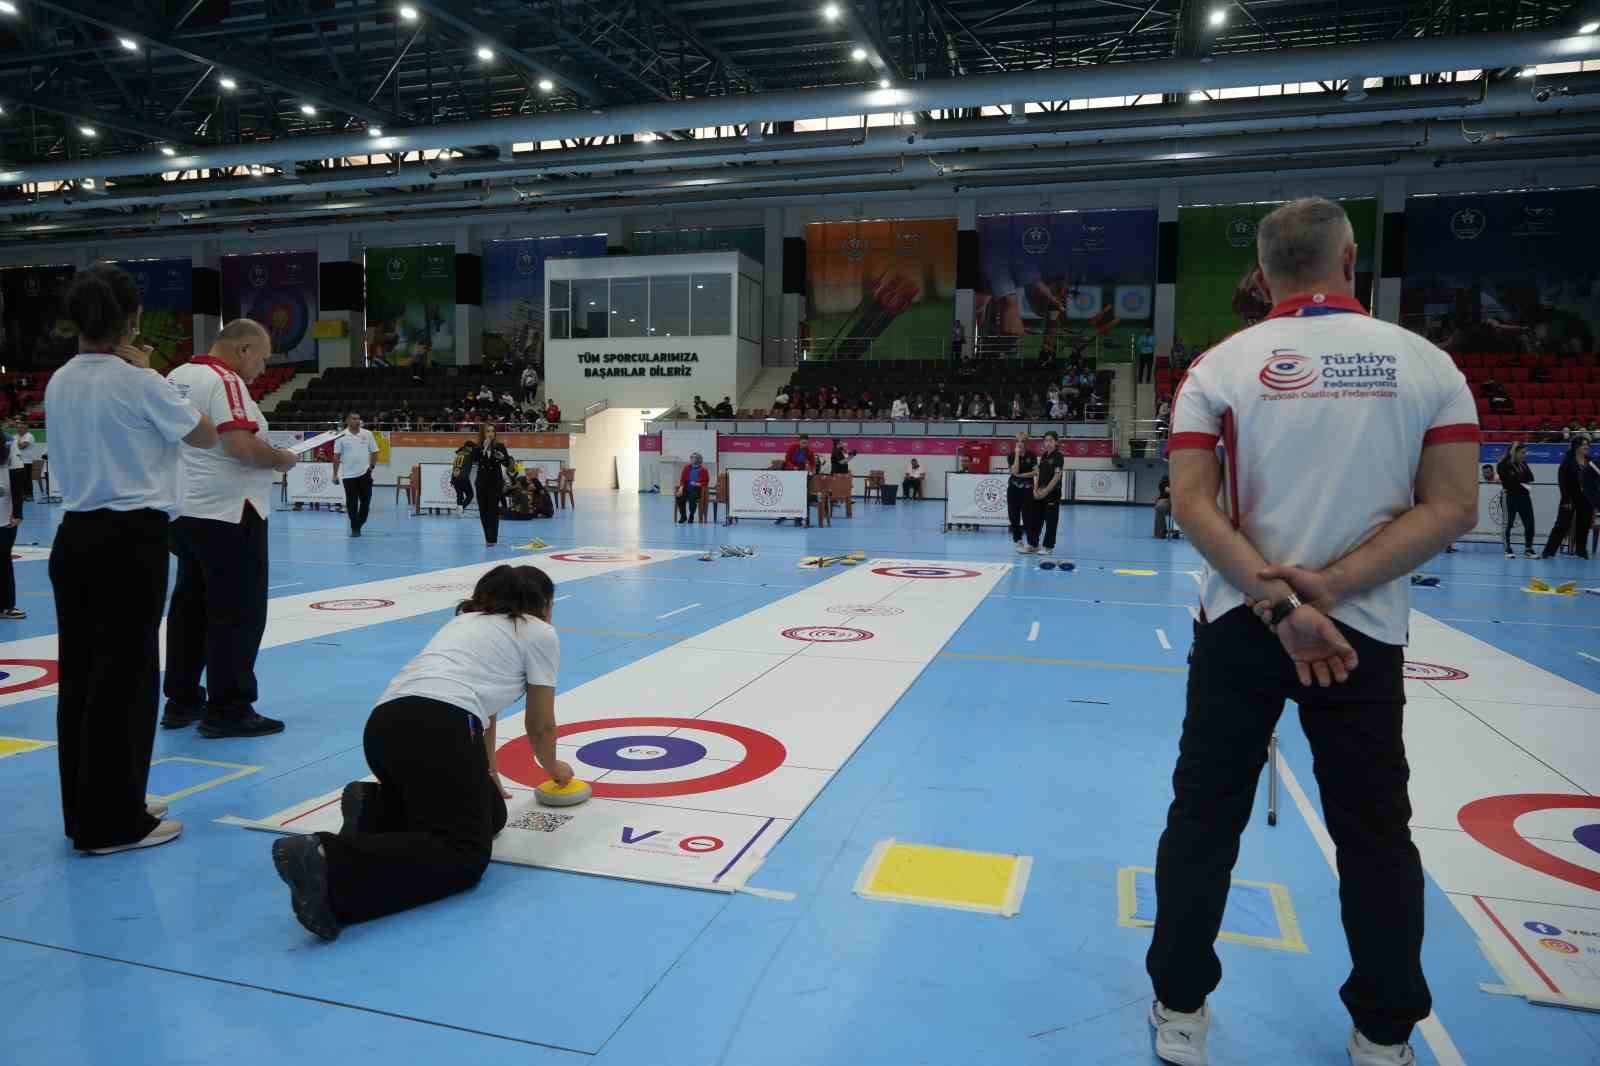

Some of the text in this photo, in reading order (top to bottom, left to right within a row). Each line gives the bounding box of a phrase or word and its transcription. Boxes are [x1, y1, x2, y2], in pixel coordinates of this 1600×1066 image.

[577, 352, 699, 364] TÜM SPORCULARIMIZA
[1321, 352, 1396, 366] Türkiye
[584, 364, 692, 379] BAŞARILAR DİLERİZ
[1322, 365, 1397, 380] Curling
[1260, 388, 1398, 401] Turkish Curling Federation
